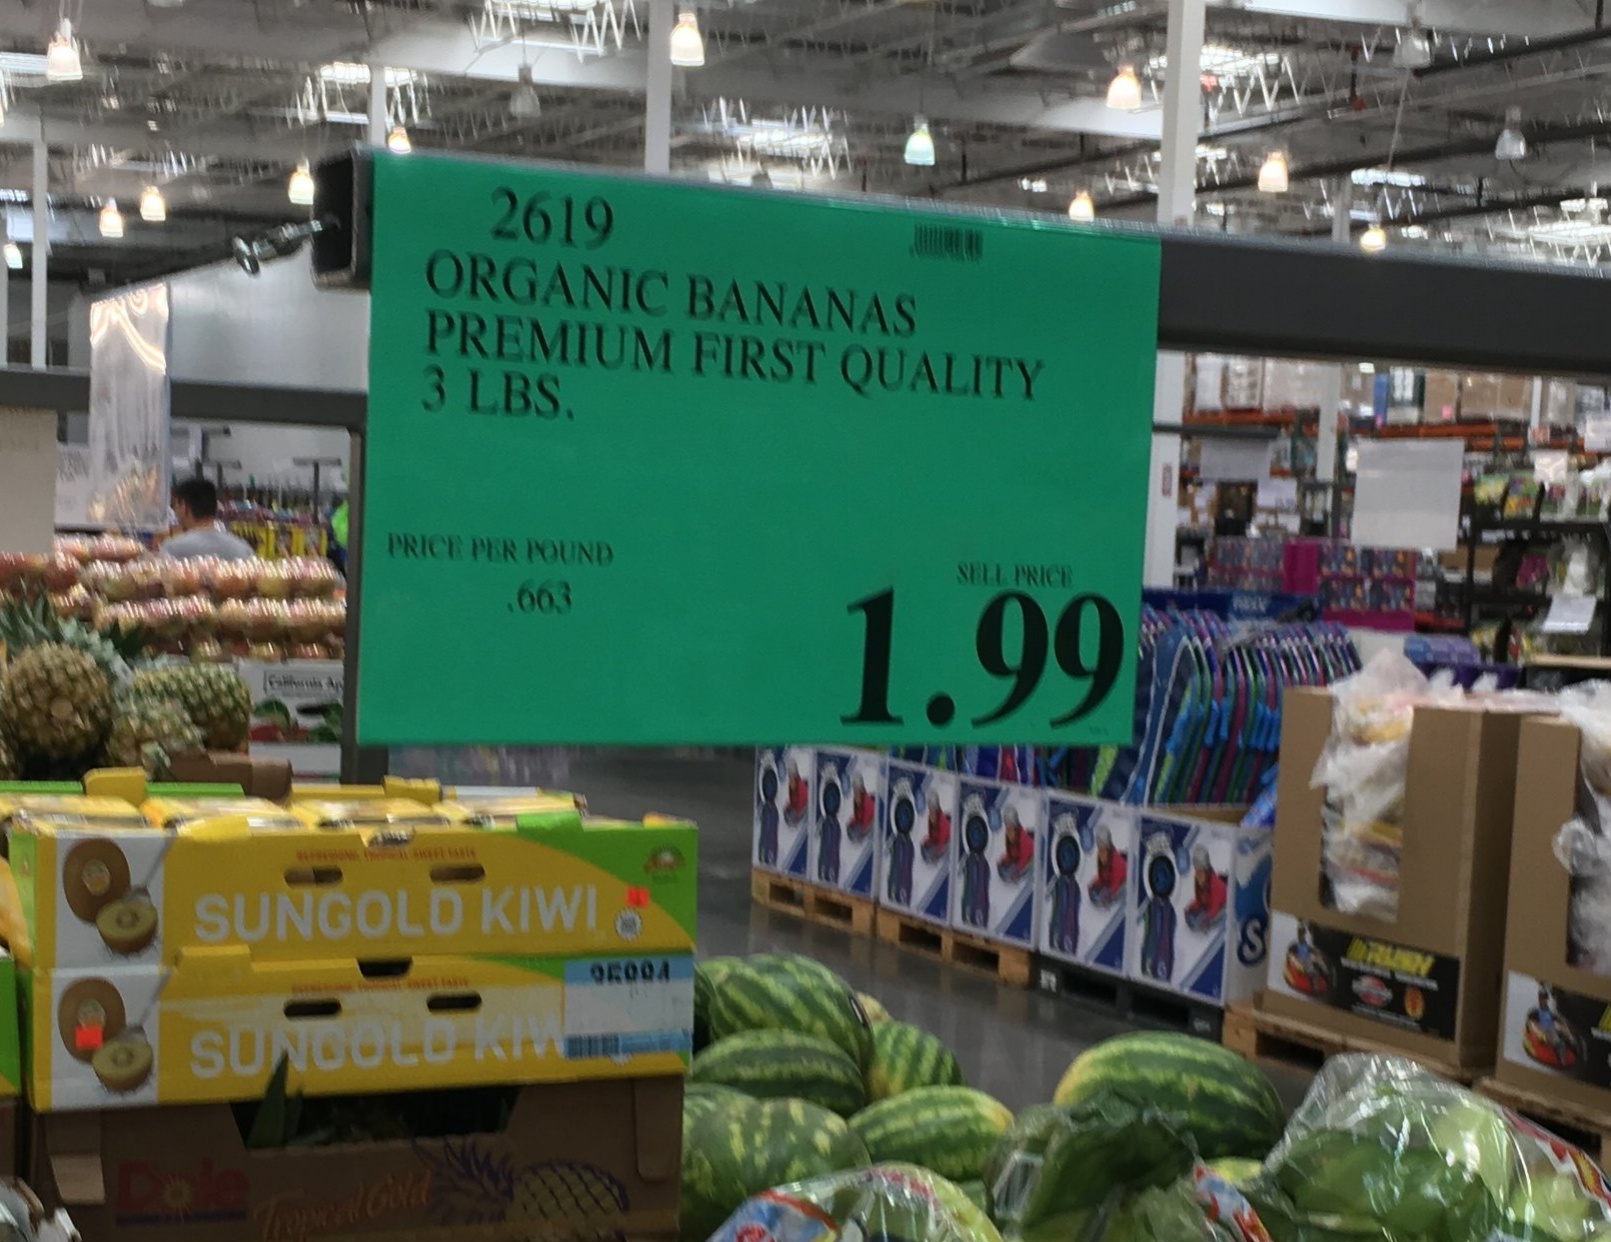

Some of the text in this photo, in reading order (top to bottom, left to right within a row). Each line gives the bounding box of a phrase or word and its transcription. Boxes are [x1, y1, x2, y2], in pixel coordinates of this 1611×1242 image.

[490, 187, 614, 250] 2619
[425, 249, 918, 338] ORGANIC BANANAS
[425, 307, 1045, 402] PREMIUM FIRST QUALITY
[420, 364, 575, 422] 3 LBS.
[386, 531, 614, 568] PRICE PER POUND
[956, 561, 1073, 592] SELL PRICE
[505, 577, 573, 617] .663
[839, 585, 1125, 731] 1.99
[194, 884, 597, 943] SUNGOLD KIWI
[190, 1010, 565, 1079] SUNGOLD KIW
[117, 1157, 249, 1214] Dole
